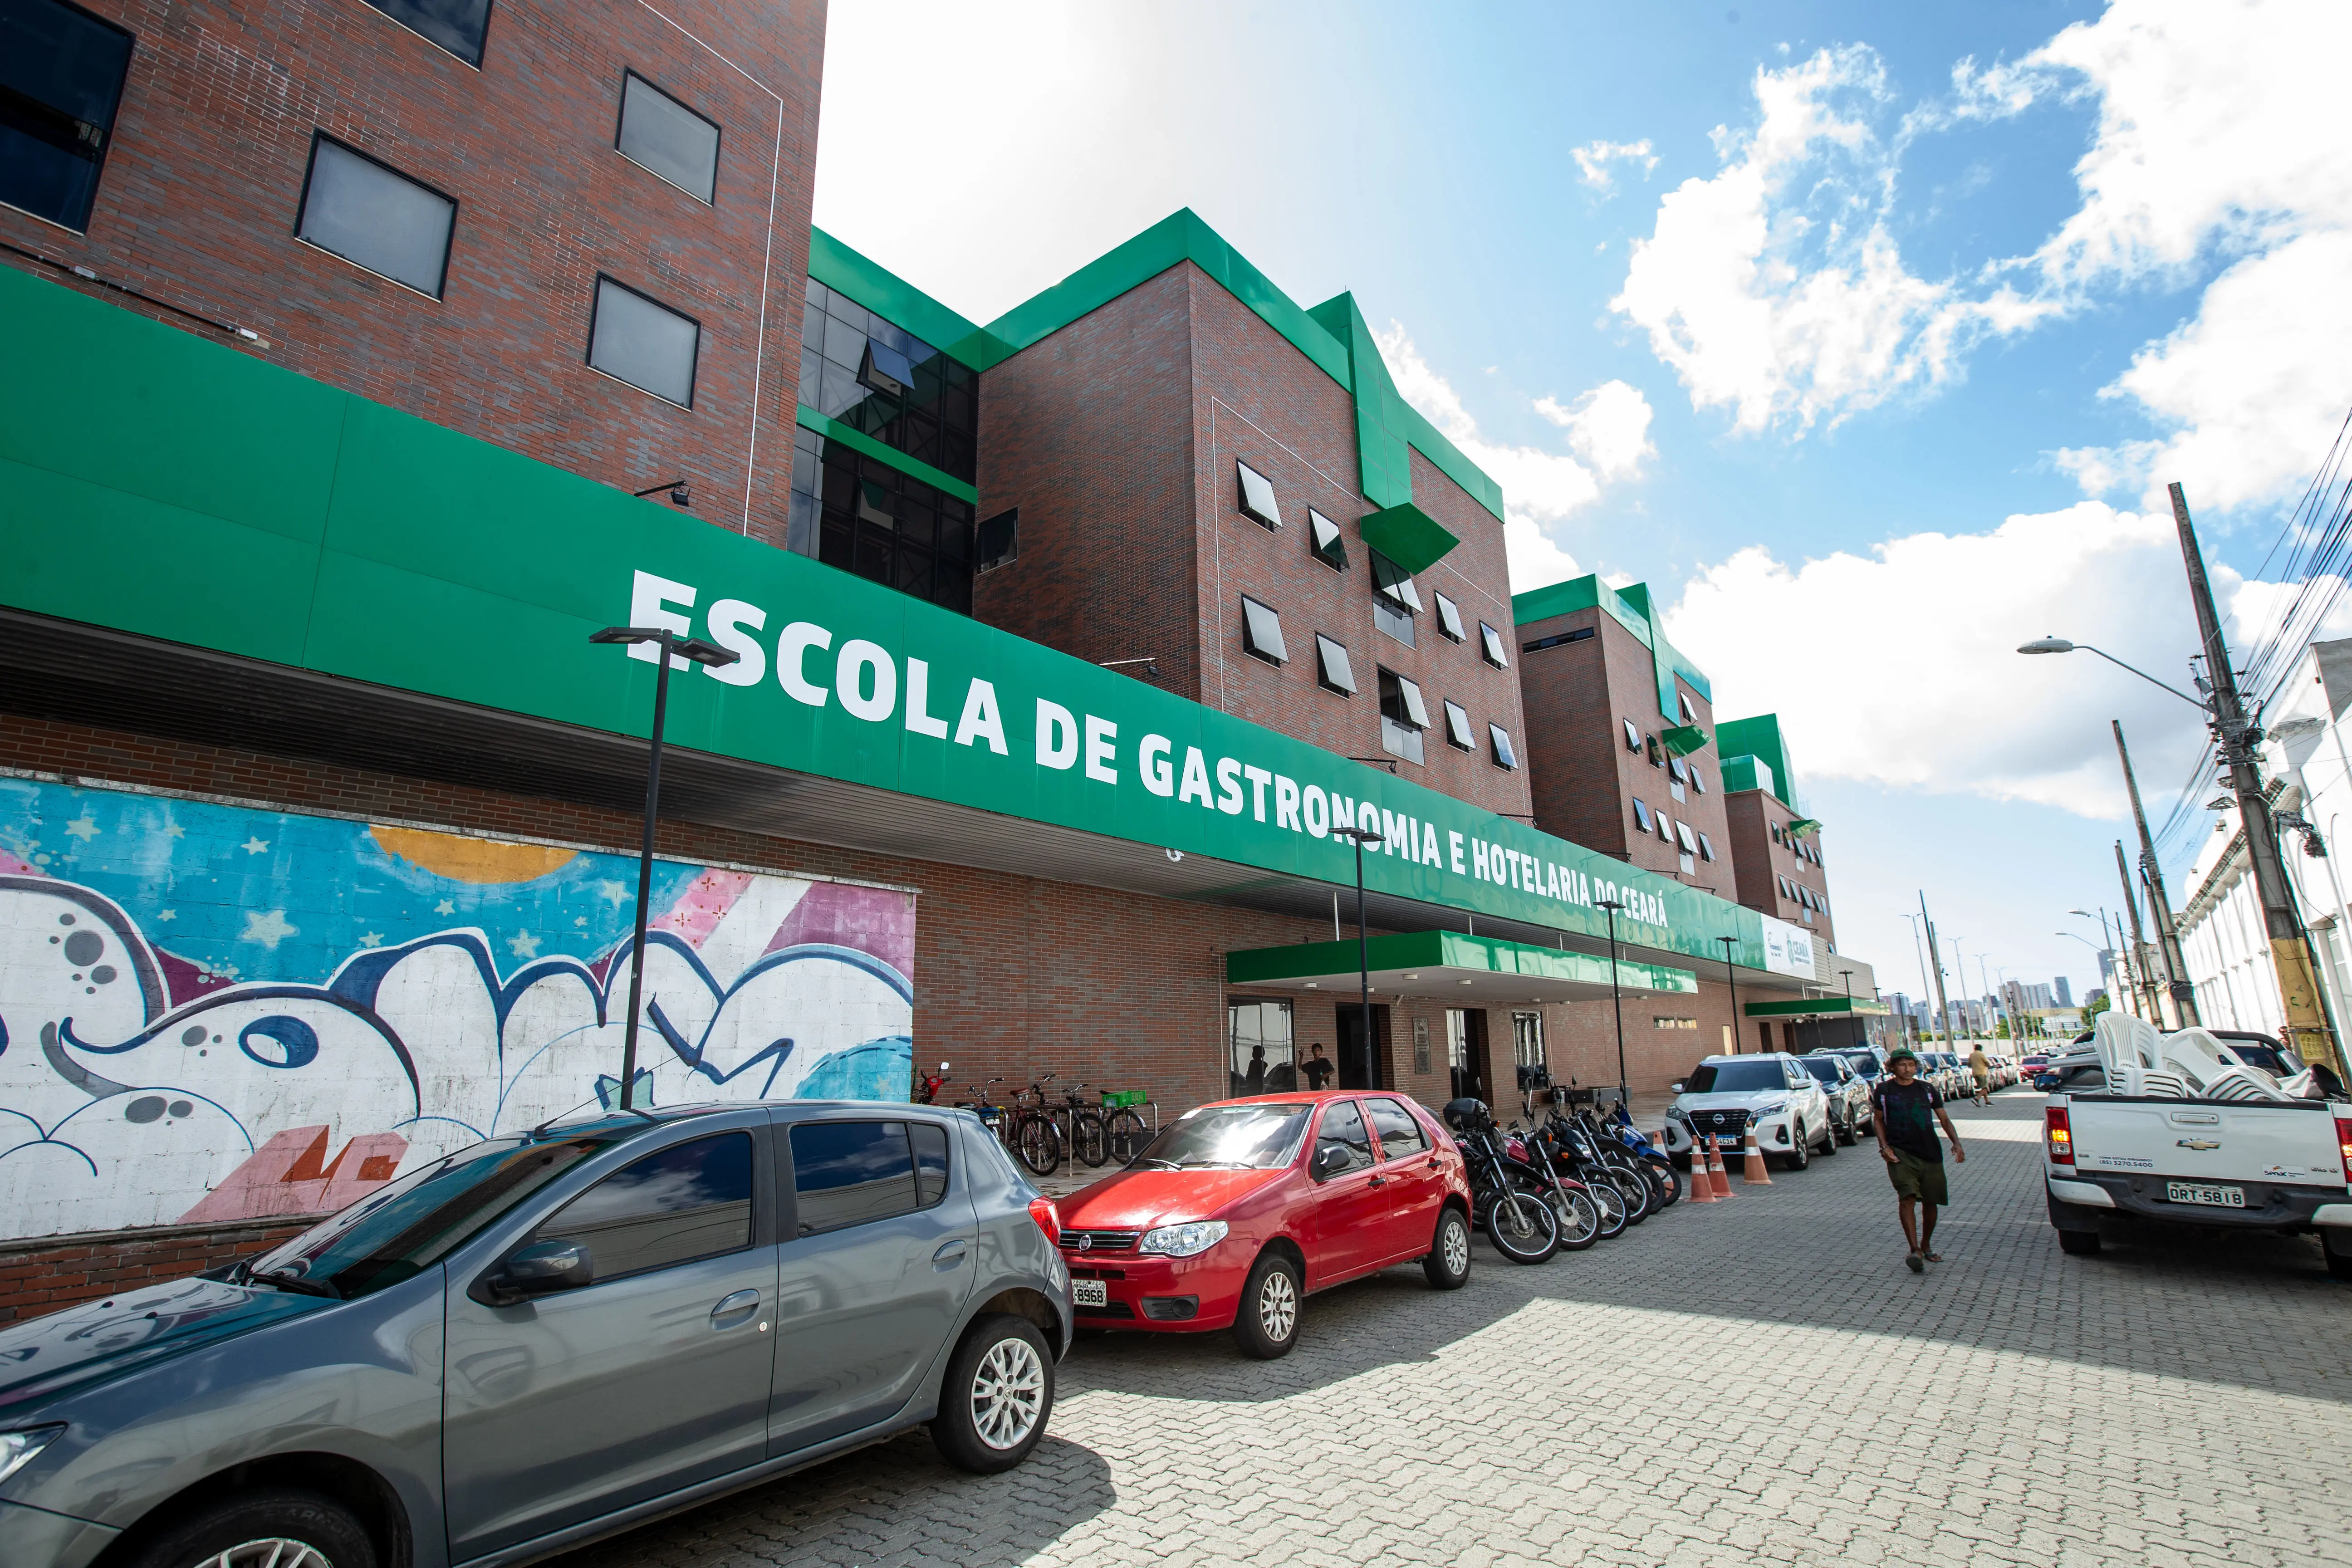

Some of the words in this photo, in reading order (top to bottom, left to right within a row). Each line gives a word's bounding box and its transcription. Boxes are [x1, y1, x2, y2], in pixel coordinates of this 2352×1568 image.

[627, 569, 1009, 756] ESCOLA
[1036, 697, 1117, 785] DE
[1139, 734, 1442, 869] GASTRONOMIA
[1449, 830, 1465, 876] E
[1472, 837, 1592, 909] HOTELARIA
[1593, 877, 1617, 914] DO
[1621, 886, 1668, 928] CEARÁ
